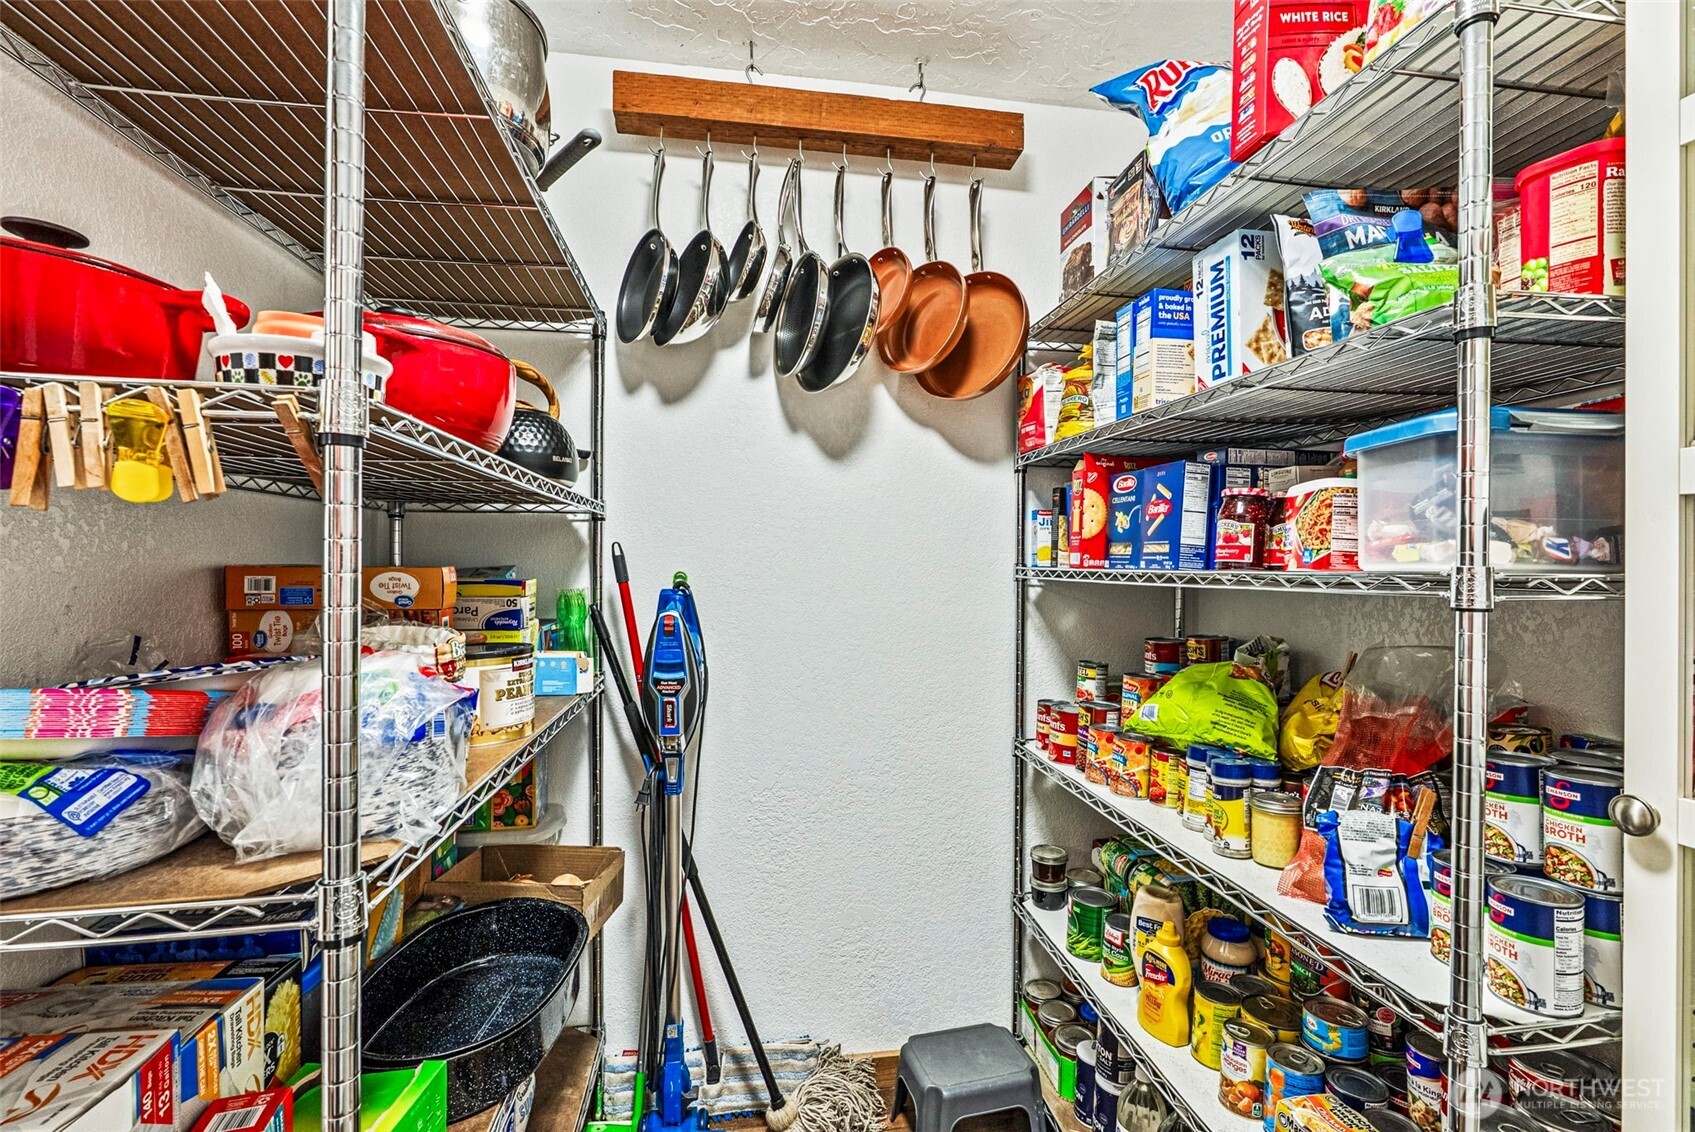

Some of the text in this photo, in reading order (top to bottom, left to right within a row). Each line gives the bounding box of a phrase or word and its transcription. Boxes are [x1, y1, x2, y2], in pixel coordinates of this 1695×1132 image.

[1280, 11, 1349, 23] WHITE RICE
[1552, 163, 1597, 180] Nutrition Facts
[1580, 181, 1597, 190] 120
[1552, 189, 1576, 200] Calories
[1241, 234, 1255, 261] 12
[1196, 279, 1204, 299] 12
[1158, 295, 1183, 304] proudly
[1165, 303, 1185, 311] baked
[1158, 311, 1190, 320] the USA
[1210, 259, 1226, 381] PREMIUM
[1124, 461, 1137, 469] RITZ
[1118, 479, 1135, 489] Barilla
[1112, 495, 1136, 504] CELLENTANI
[1148, 503, 1170, 514] Barilla
[391, 582, 411, 590] Twist
[506, 598, 518, 608] 50
[453, 606, 479, 617] Parc
[232, 633, 243, 649] 100
[1546, 787, 1578, 800] SWANSON
[1545, 818, 1583, 834] CHICKEN
[1545, 827, 1586, 844] BROTH
[1138, 919, 1153, 929] Best
[1111, 950, 1129, 962] Corn
[1145, 968, 1166, 982] French's
[179, 1014, 197, 1022] Tall
[246, 989, 261, 1062] HDX
[208, 1029, 216, 1052] 2X
[234, 1026, 242, 1068] Kitchen
[67, 1034, 158, 1082] HDX
[46, 1048, 100, 1082] Kitchen
[1422, 1085, 1443, 1099] King
[143, 1090, 153, 1120] 140
[158, 1092, 170, 1118] 13
